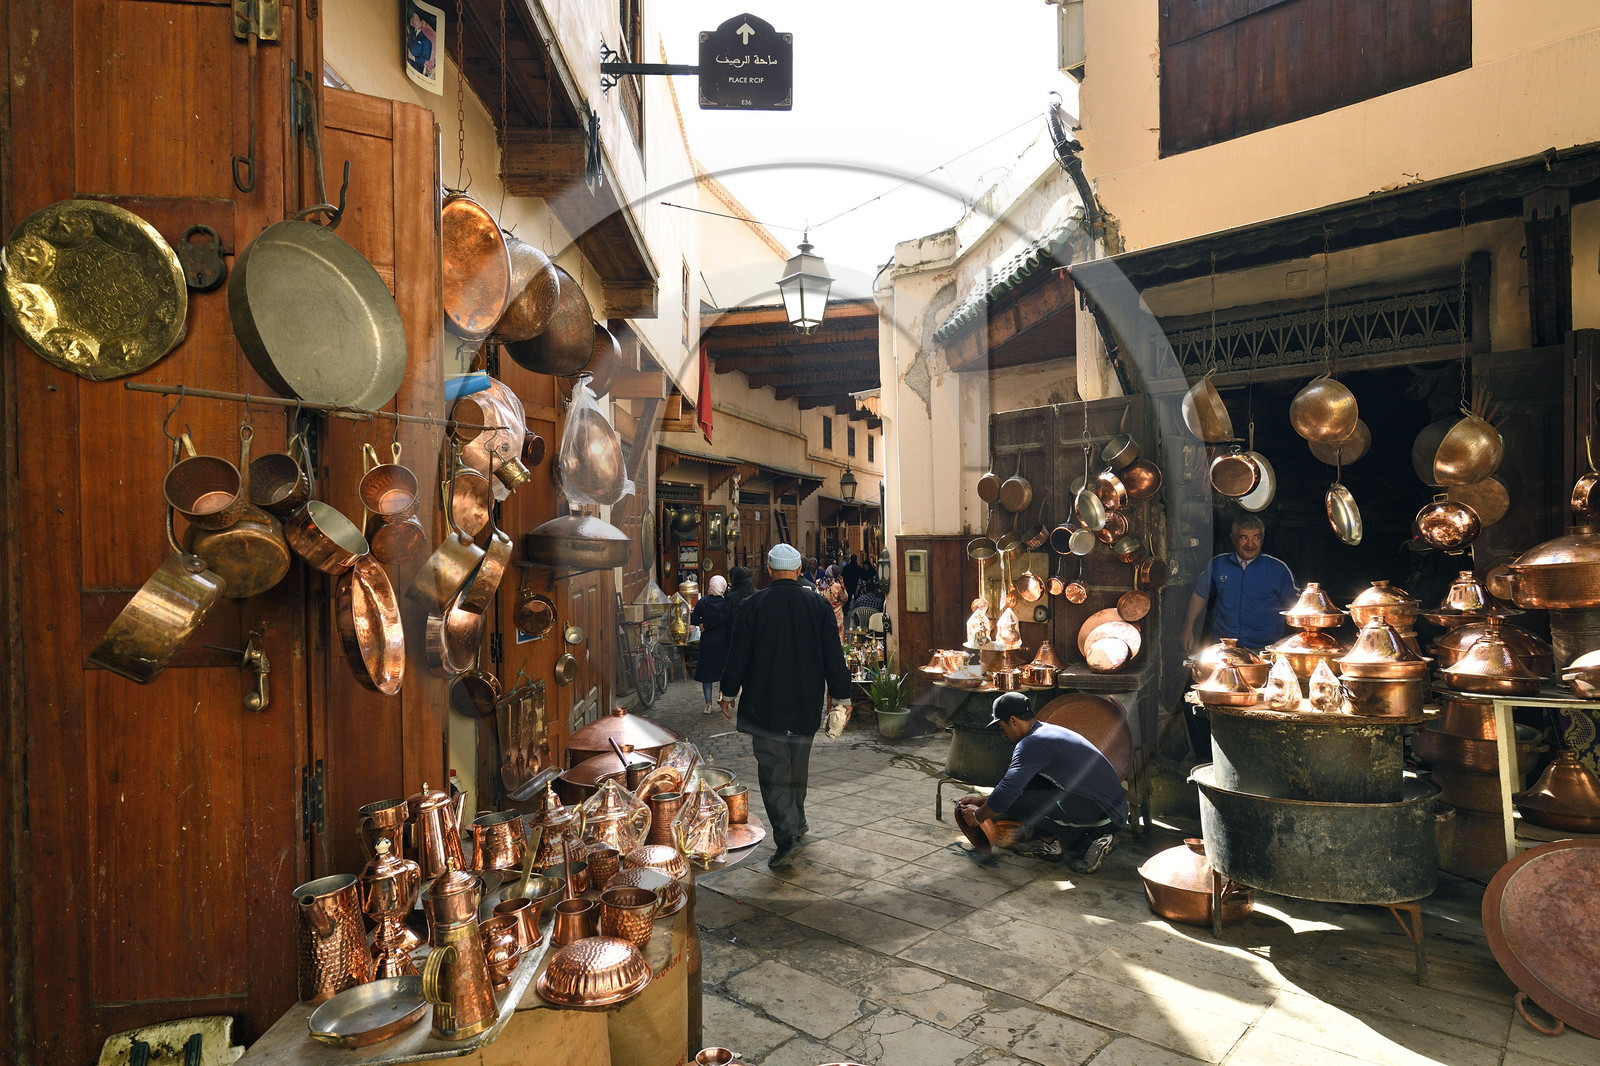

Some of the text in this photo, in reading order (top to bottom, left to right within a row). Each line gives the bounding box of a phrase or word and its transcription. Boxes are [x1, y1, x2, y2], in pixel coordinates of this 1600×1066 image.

[715, 54, 778, 68] ساحة الرصيف
[728, 76, 748, 84] PLACE
